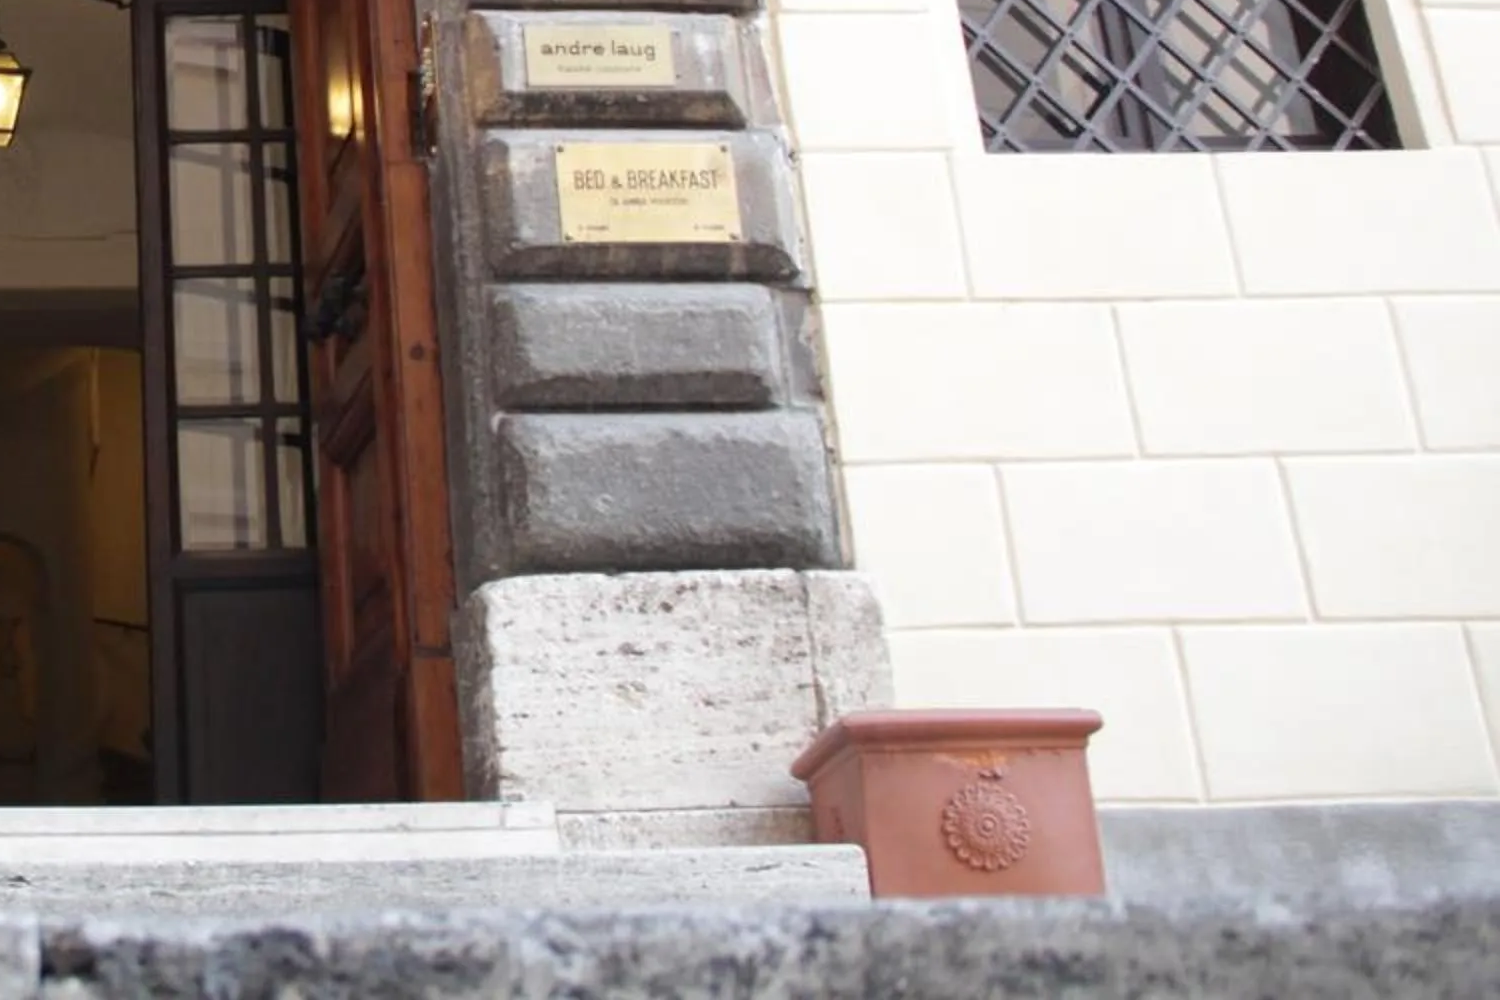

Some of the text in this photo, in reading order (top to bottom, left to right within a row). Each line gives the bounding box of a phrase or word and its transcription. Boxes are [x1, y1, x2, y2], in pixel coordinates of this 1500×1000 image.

[540, 39, 656, 61] andre laug
[573, 168, 718, 190] BED & BREAKFAST
